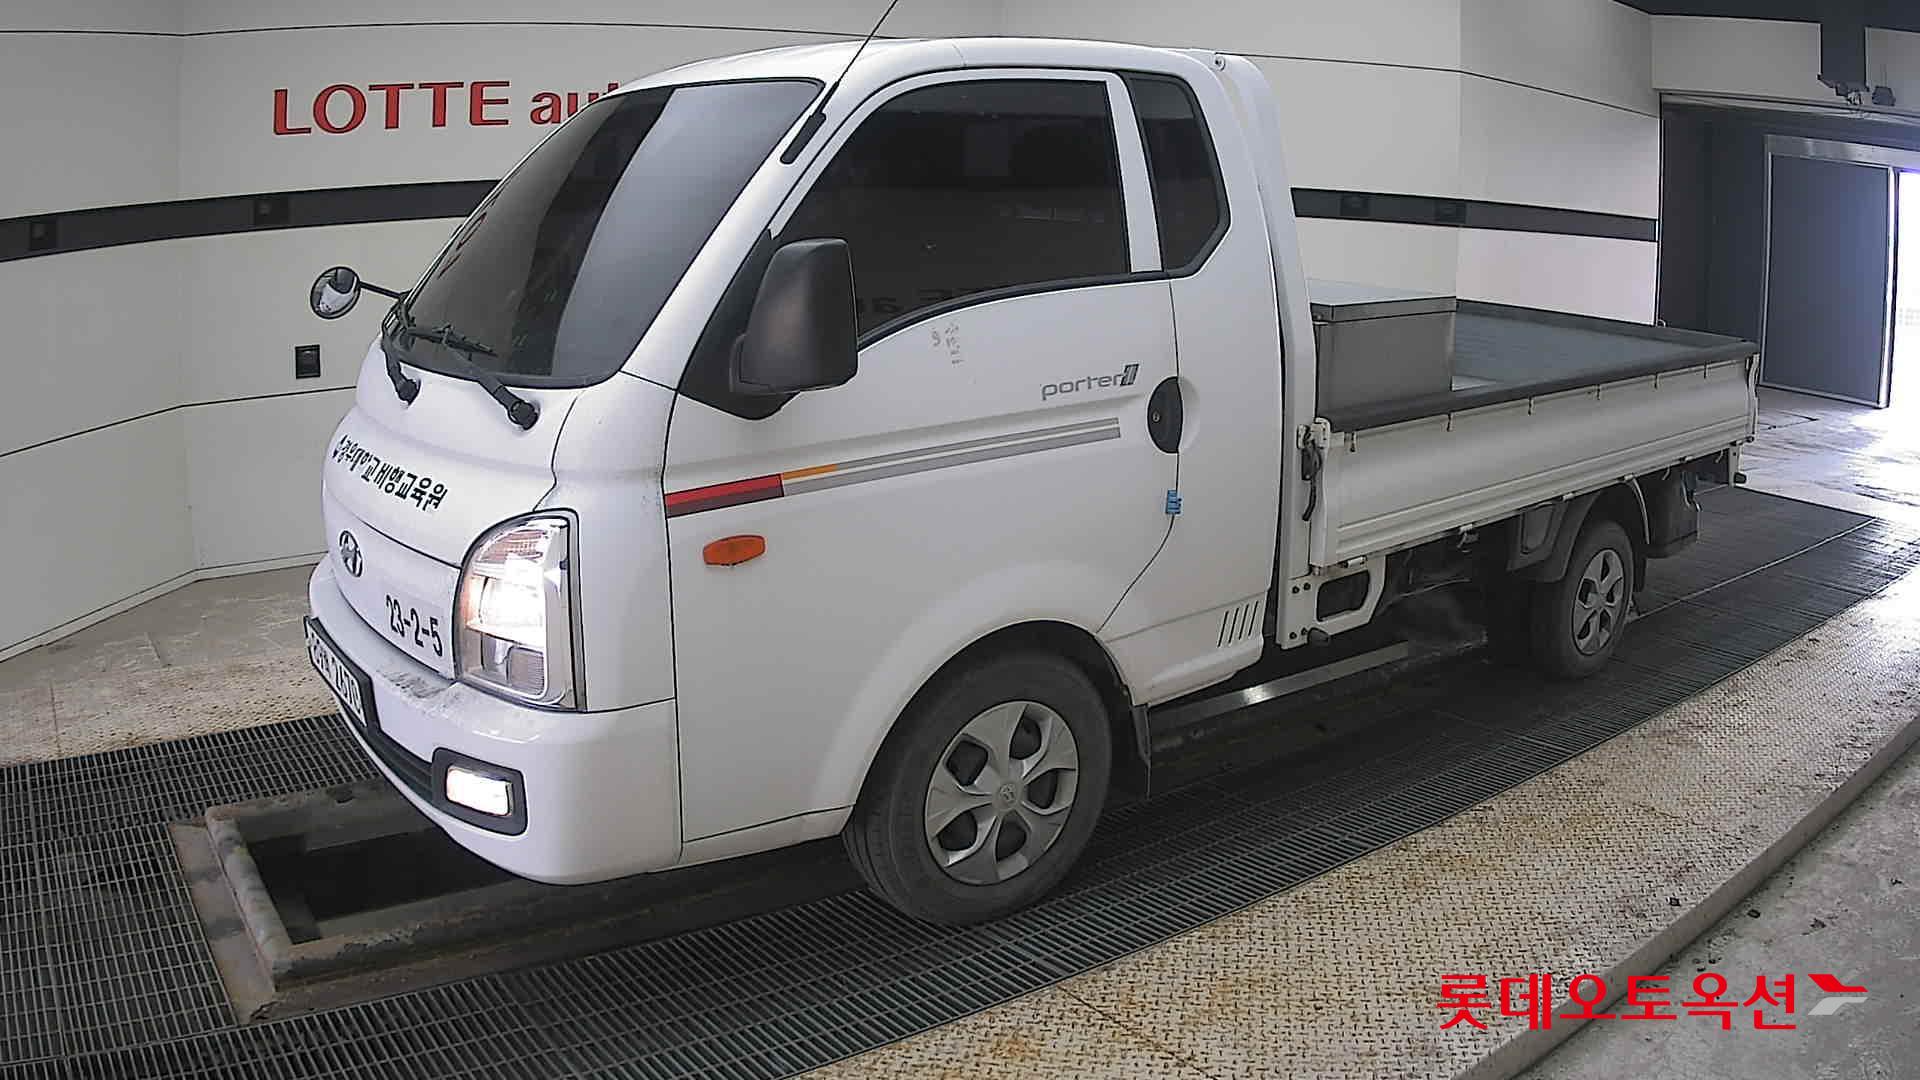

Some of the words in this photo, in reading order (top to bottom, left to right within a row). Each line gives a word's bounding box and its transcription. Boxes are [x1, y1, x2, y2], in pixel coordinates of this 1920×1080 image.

[273, 81, 510, 135] LOTTE
[1041, 372, 1124, 401] porter
[386, 594, 443, 657] 23-2-5
